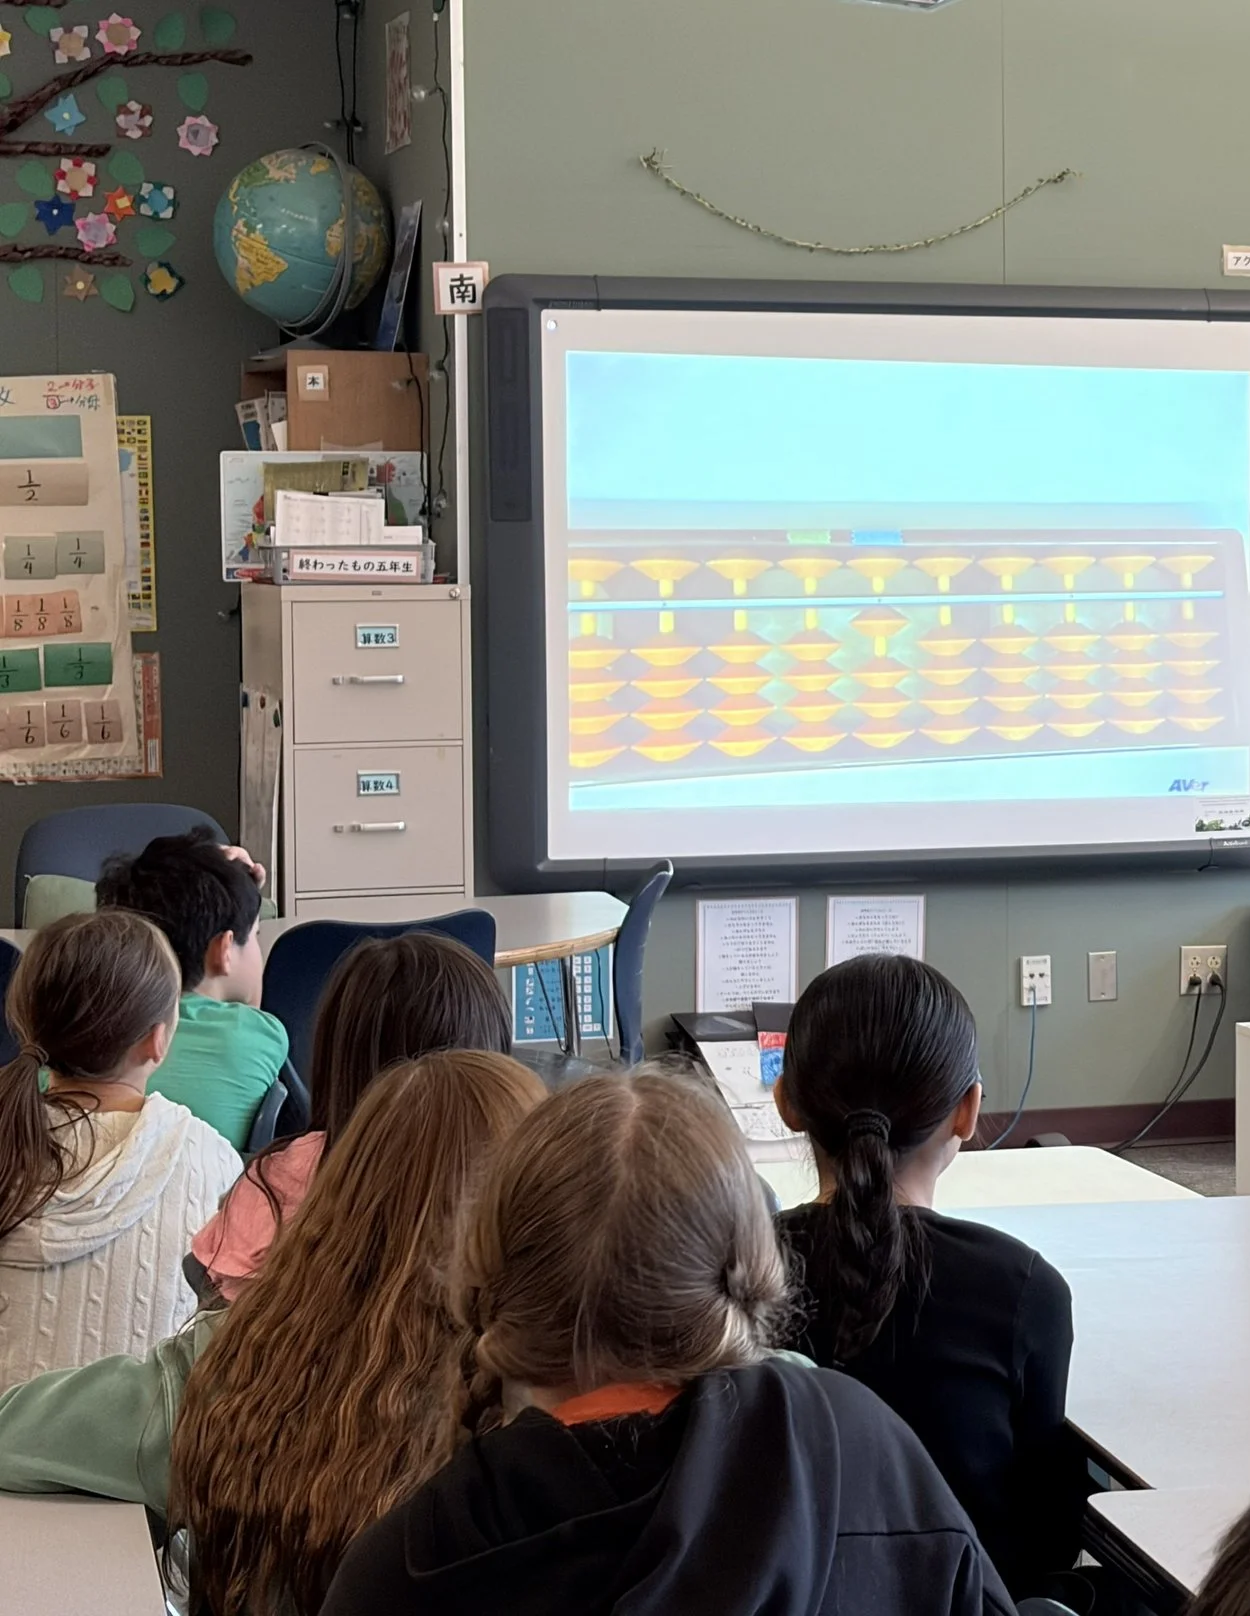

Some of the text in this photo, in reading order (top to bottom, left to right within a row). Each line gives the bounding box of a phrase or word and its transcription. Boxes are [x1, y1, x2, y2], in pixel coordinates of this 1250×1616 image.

[449, 273, 477, 304] 南
[307, 376, 320, 388] 本
[298, 558, 414, 573] 終わったもの五年生
[1169, 779, 1209, 792] AVer
